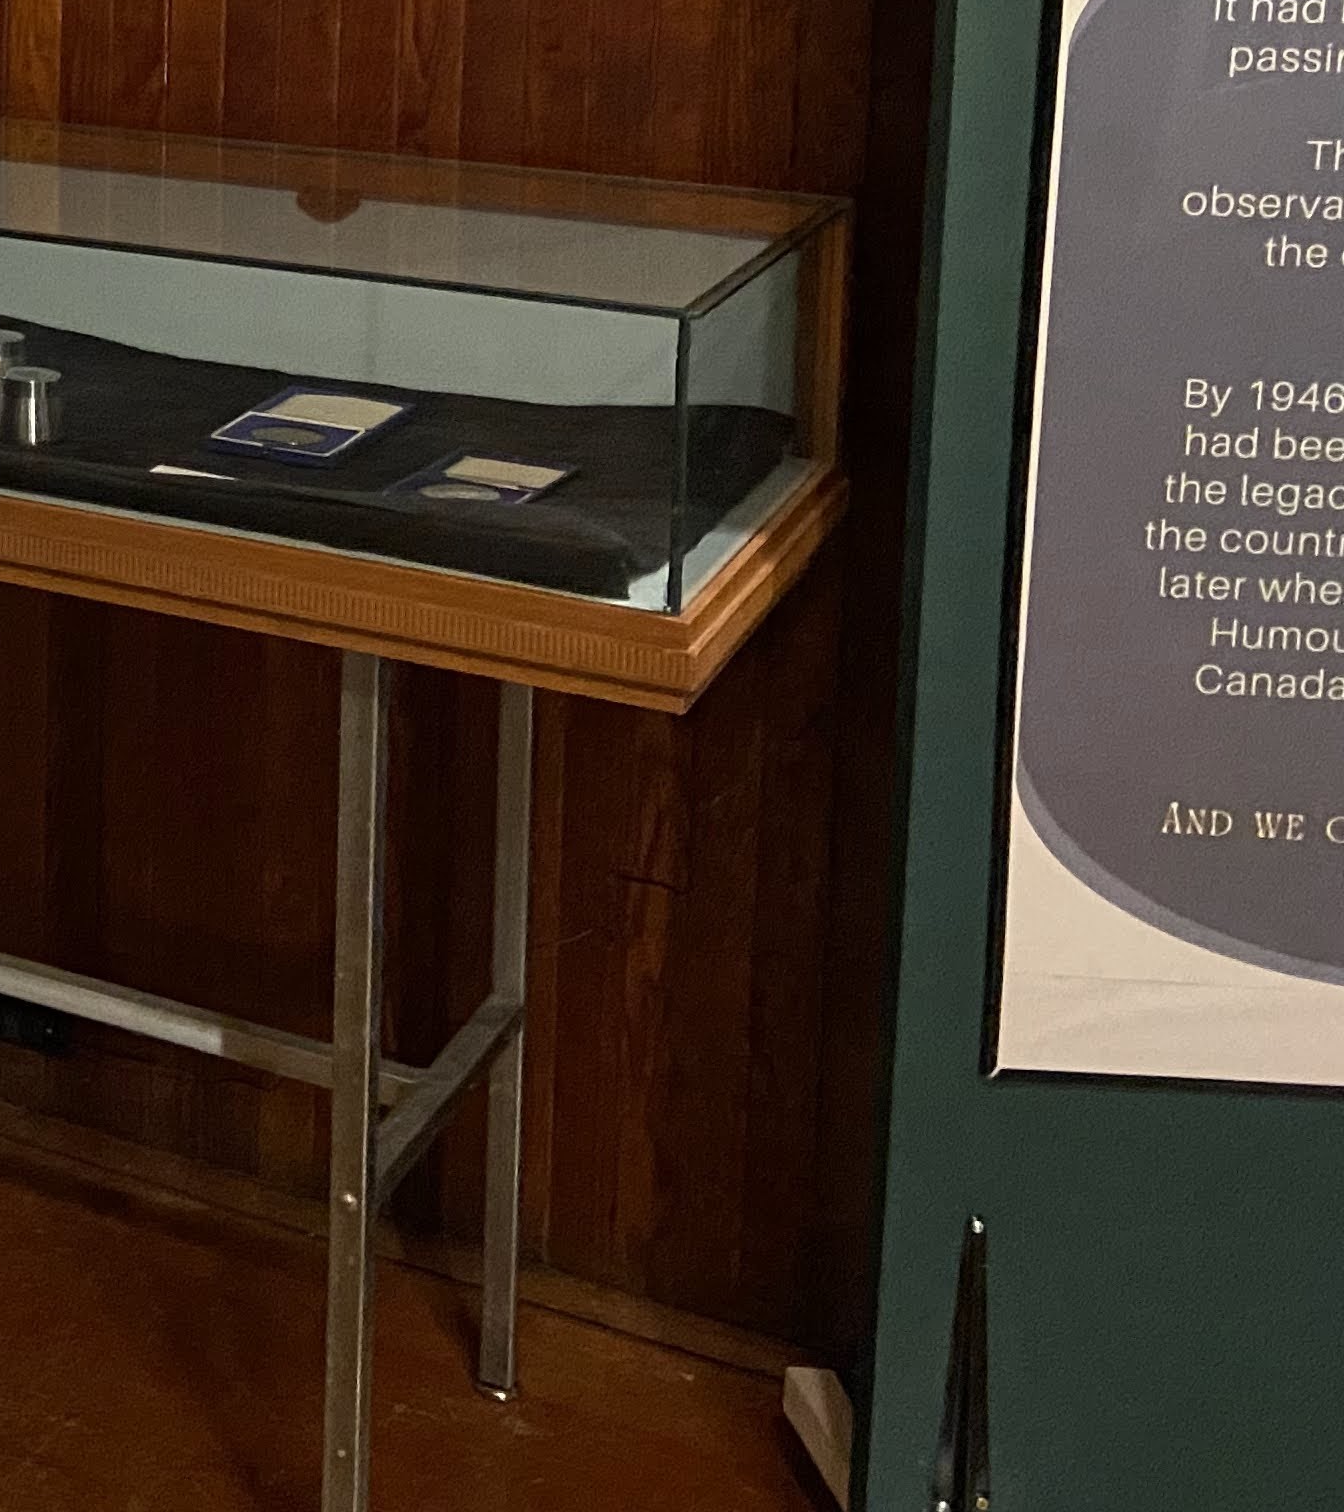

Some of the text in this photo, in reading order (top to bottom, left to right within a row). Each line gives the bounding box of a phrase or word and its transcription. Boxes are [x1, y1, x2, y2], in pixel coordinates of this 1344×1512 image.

[1265, 235, 1329, 269] the
[1184, 379, 1344, 418] By 1946
[1185, 424, 1259, 459] had
[1165, 472, 1228, 506] the
[1144, 519, 1208, 553] the
[1159, 566, 1247, 601] later
